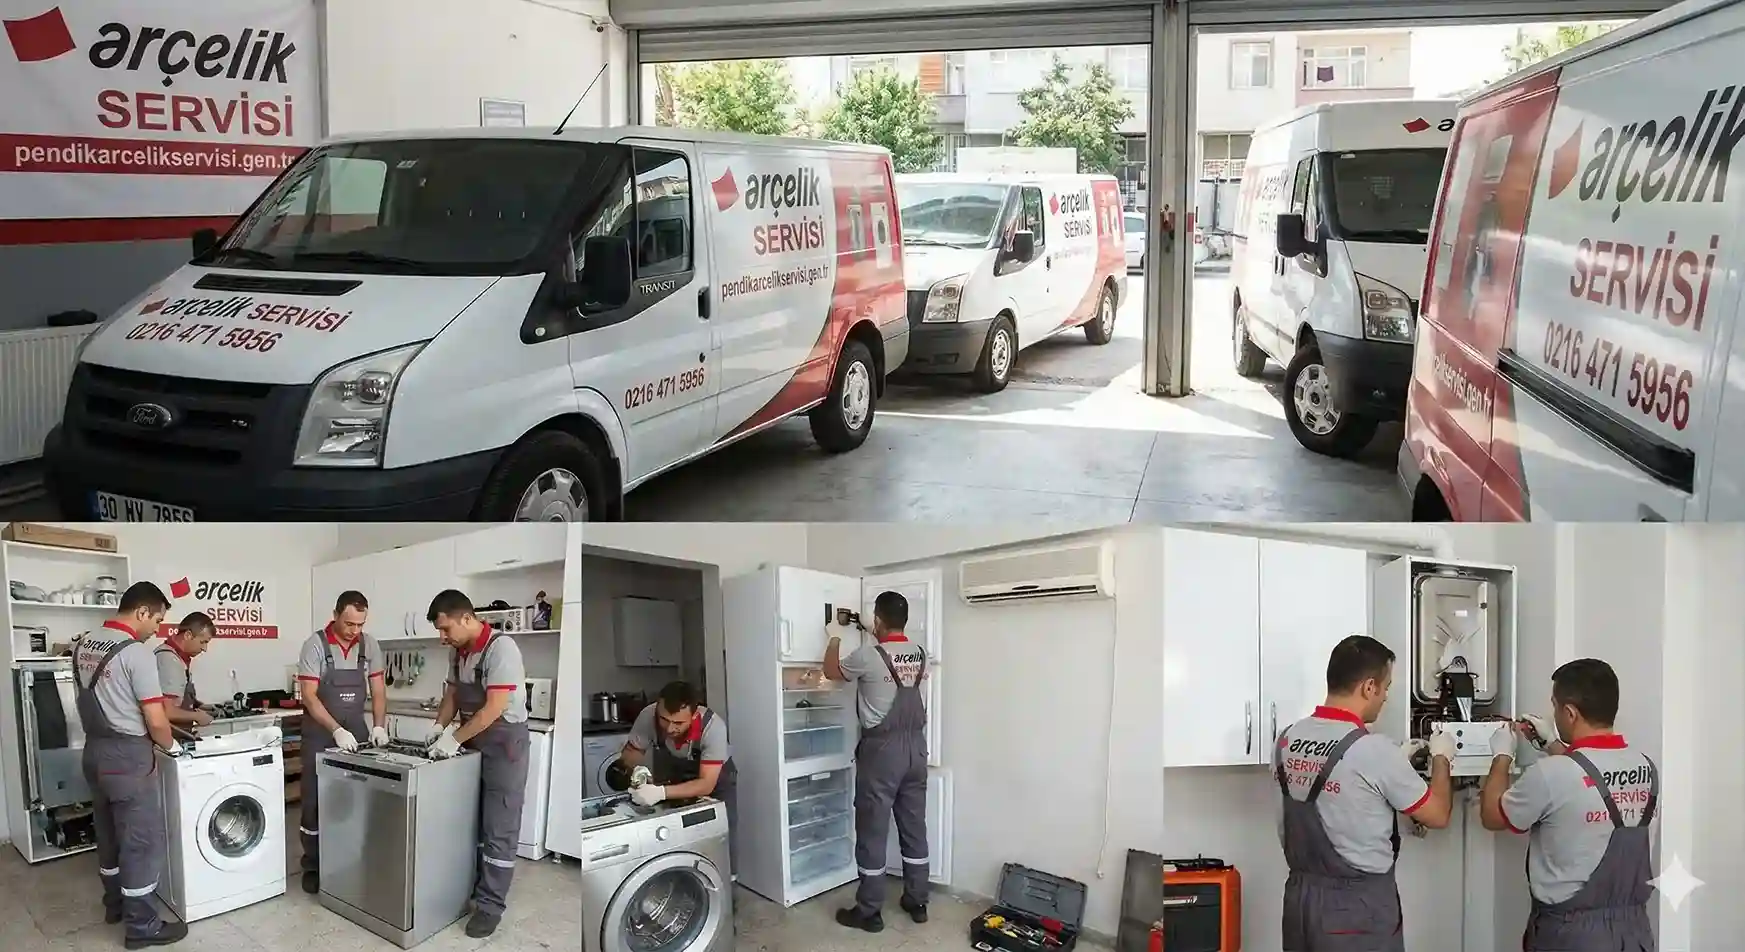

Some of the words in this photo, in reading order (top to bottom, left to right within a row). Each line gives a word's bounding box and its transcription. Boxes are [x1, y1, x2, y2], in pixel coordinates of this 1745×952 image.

[89, 22, 296, 87] arçelik
[97, 89, 293, 137] SERVİSİ
[1579, 85, 1745, 223] arçelik
[745, 167, 820, 218] arçelik
[1061, 188, 1090, 217] arçelik
[753, 215, 825, 256] SERVİSİ
[640, 280, 676, 294] TRANSIT
[721, 264, 829, 302] pendikarcelikservisi.gen.tr
[1570, 231, 1719, 332] SERVİSİ
[160, 297, 253, 320] arçelik
[247, 303, 353, 332] SERVİSİ
[125, 322, 175, 341] 0216
[176, 323, 223, 345] 471
[218, 328, 283, 352] 5956
[625, 383, 654, 409] 0216
[656, 376, 676, 399] 471
[679, 367, 704, 392] 5956
[1544, 320, 1583, 378] 0216
[1585, 337, 1623, 397] 471
[1627, 352, 1693, 431] 5956
[195, 580, 264, 605] arçelik
[206, 606, 262, 623] SERVİSİ
[1286, 757, 1325, 773] SERVİS
[1289, 738, 1339, 758] arçeli
[1586, 811, 1608, 823] 021
